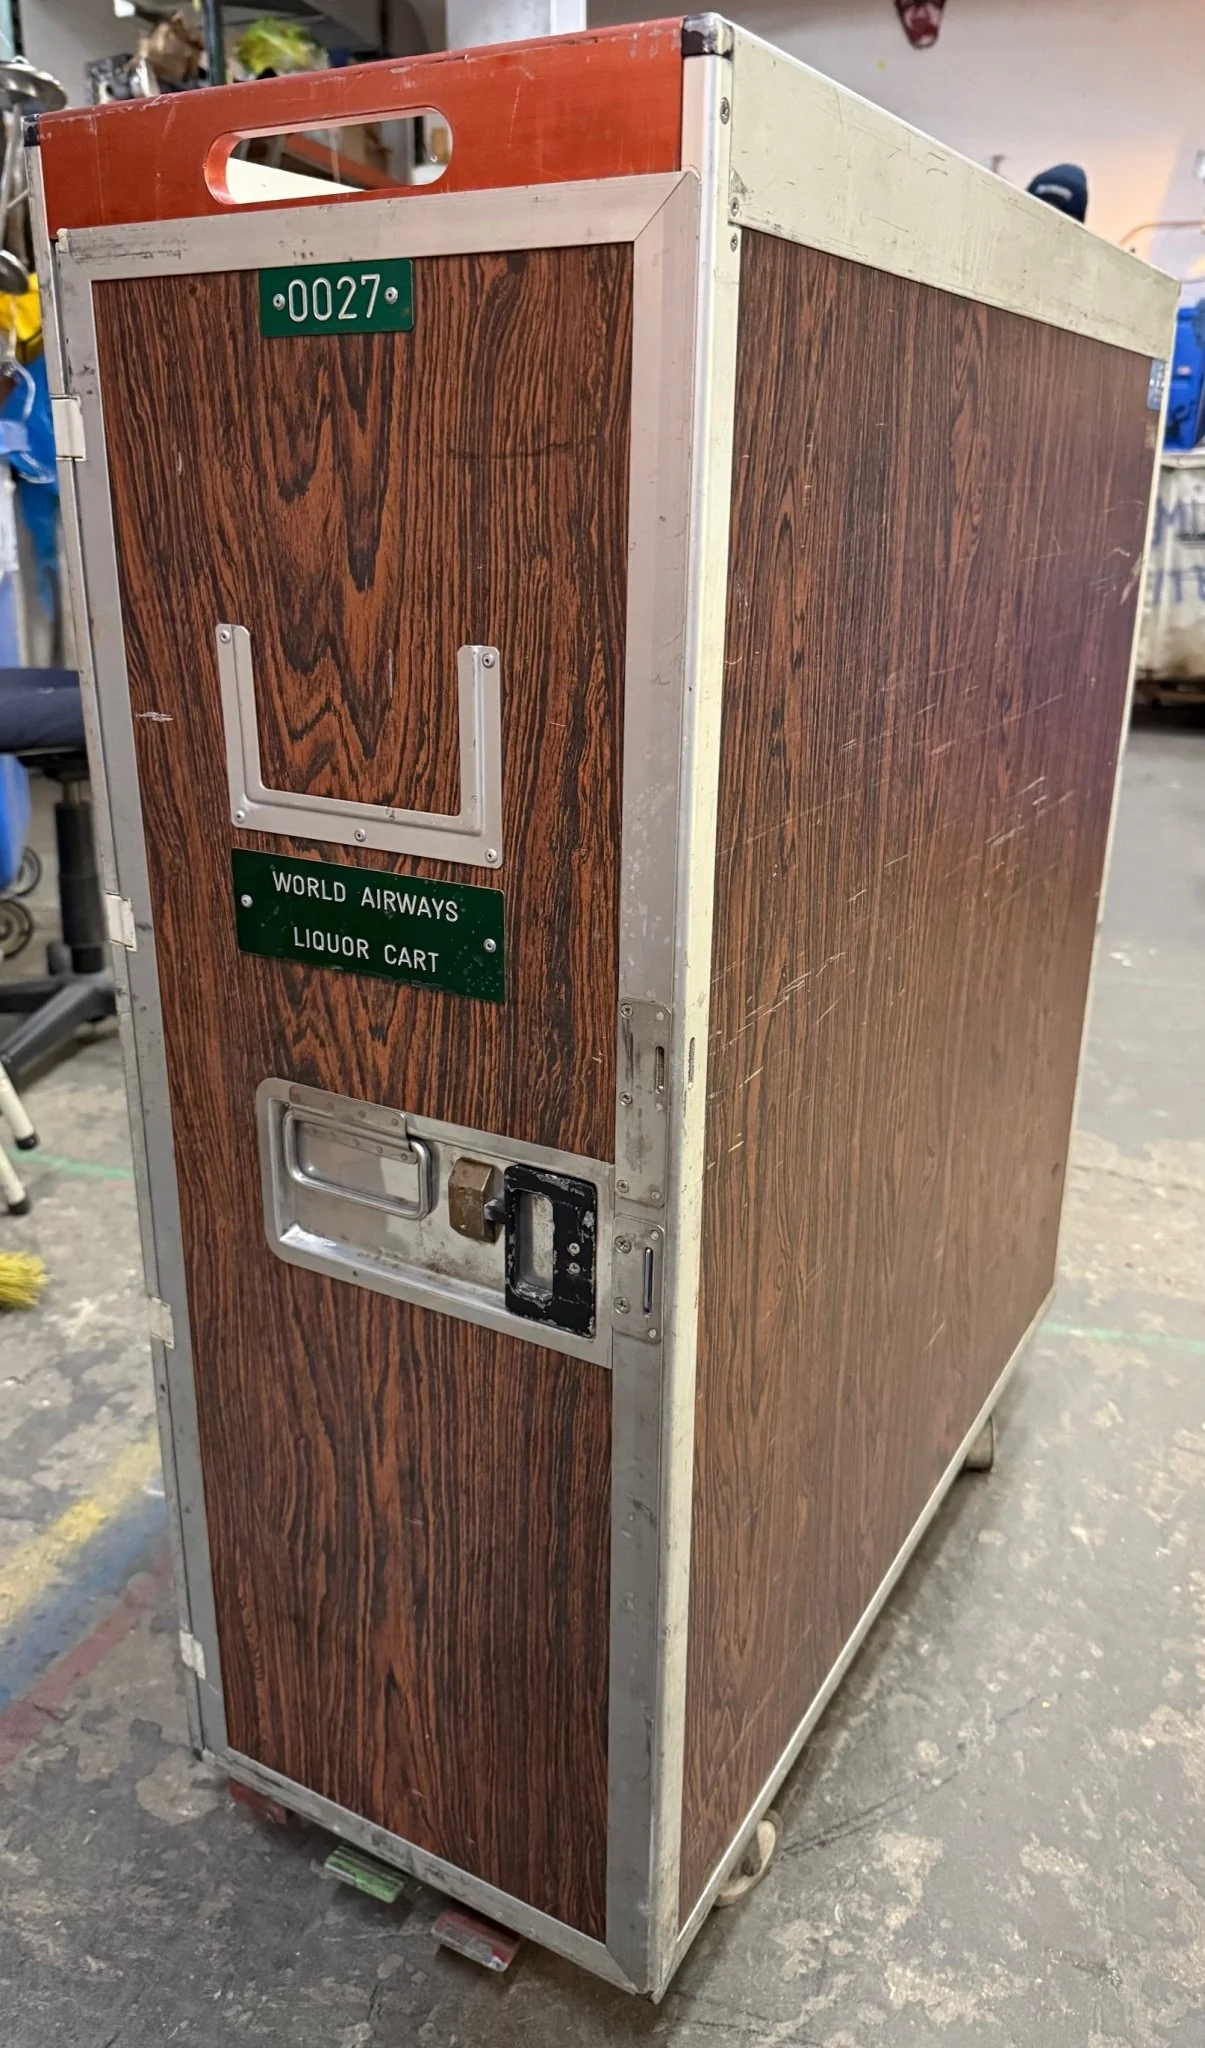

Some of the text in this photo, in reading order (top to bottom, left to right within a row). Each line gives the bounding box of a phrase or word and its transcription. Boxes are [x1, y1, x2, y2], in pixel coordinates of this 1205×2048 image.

[288, 273, 381, 322] 0027
[272, 870, 459, 922] WORLD AIRWAYS
[293, 926, 440, 973] LIQUOR CART
